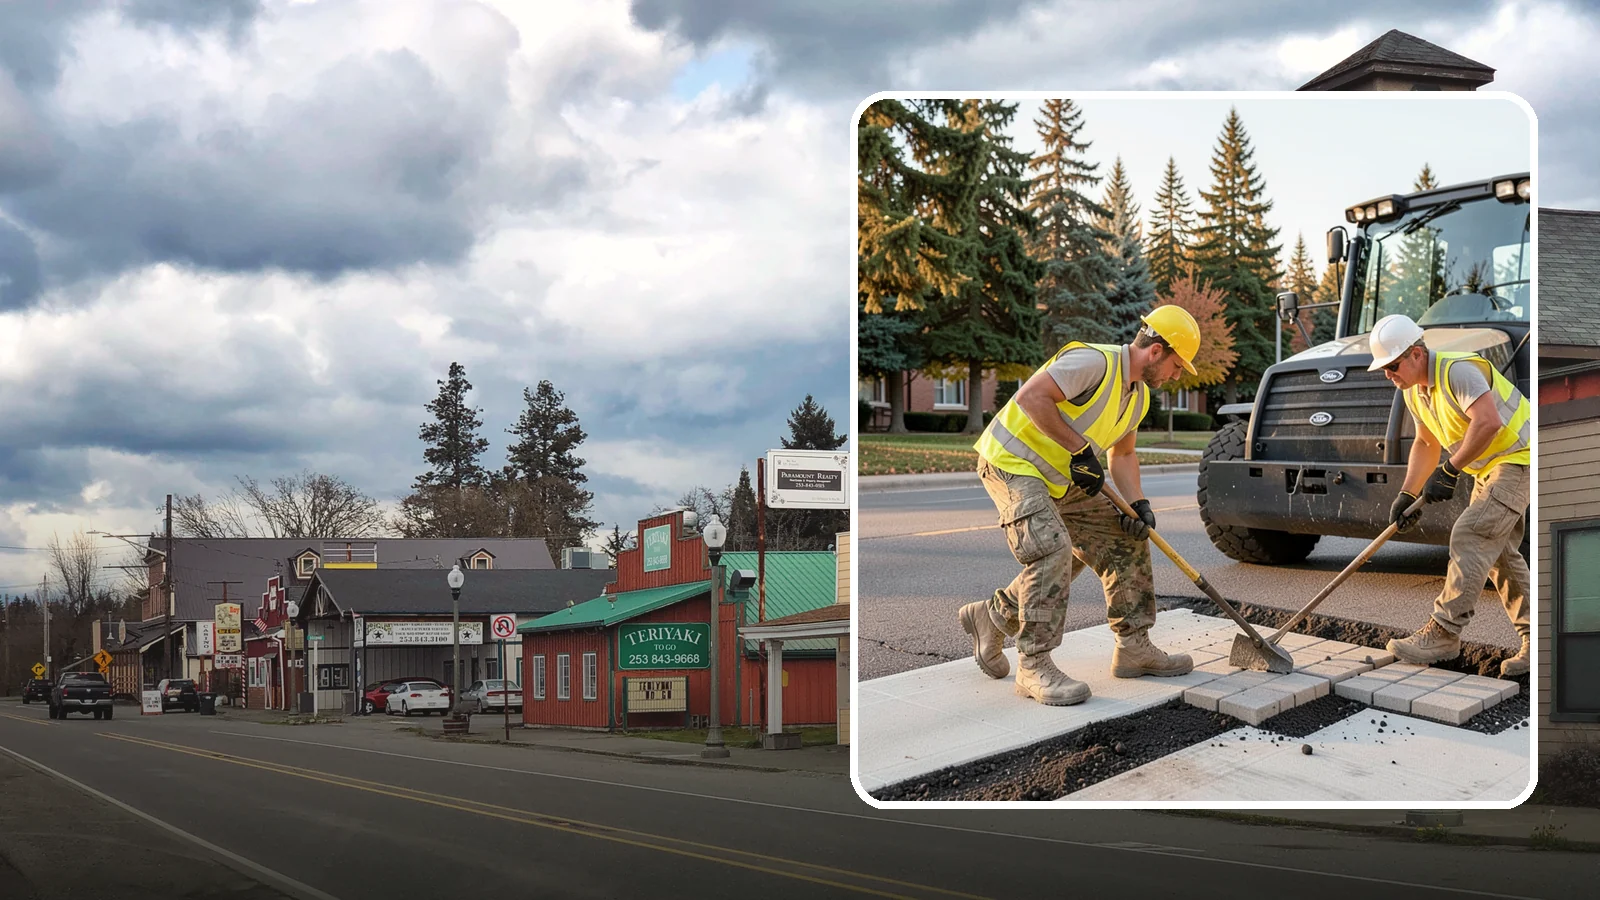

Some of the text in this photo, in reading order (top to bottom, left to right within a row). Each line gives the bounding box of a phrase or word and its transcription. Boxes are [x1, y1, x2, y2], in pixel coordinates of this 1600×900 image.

[625, 627, 702, 646] TERIYAKI
[628, 654, 700, 665] 253 843-9668
[639, 681, 673, 691] TERIYAKI
